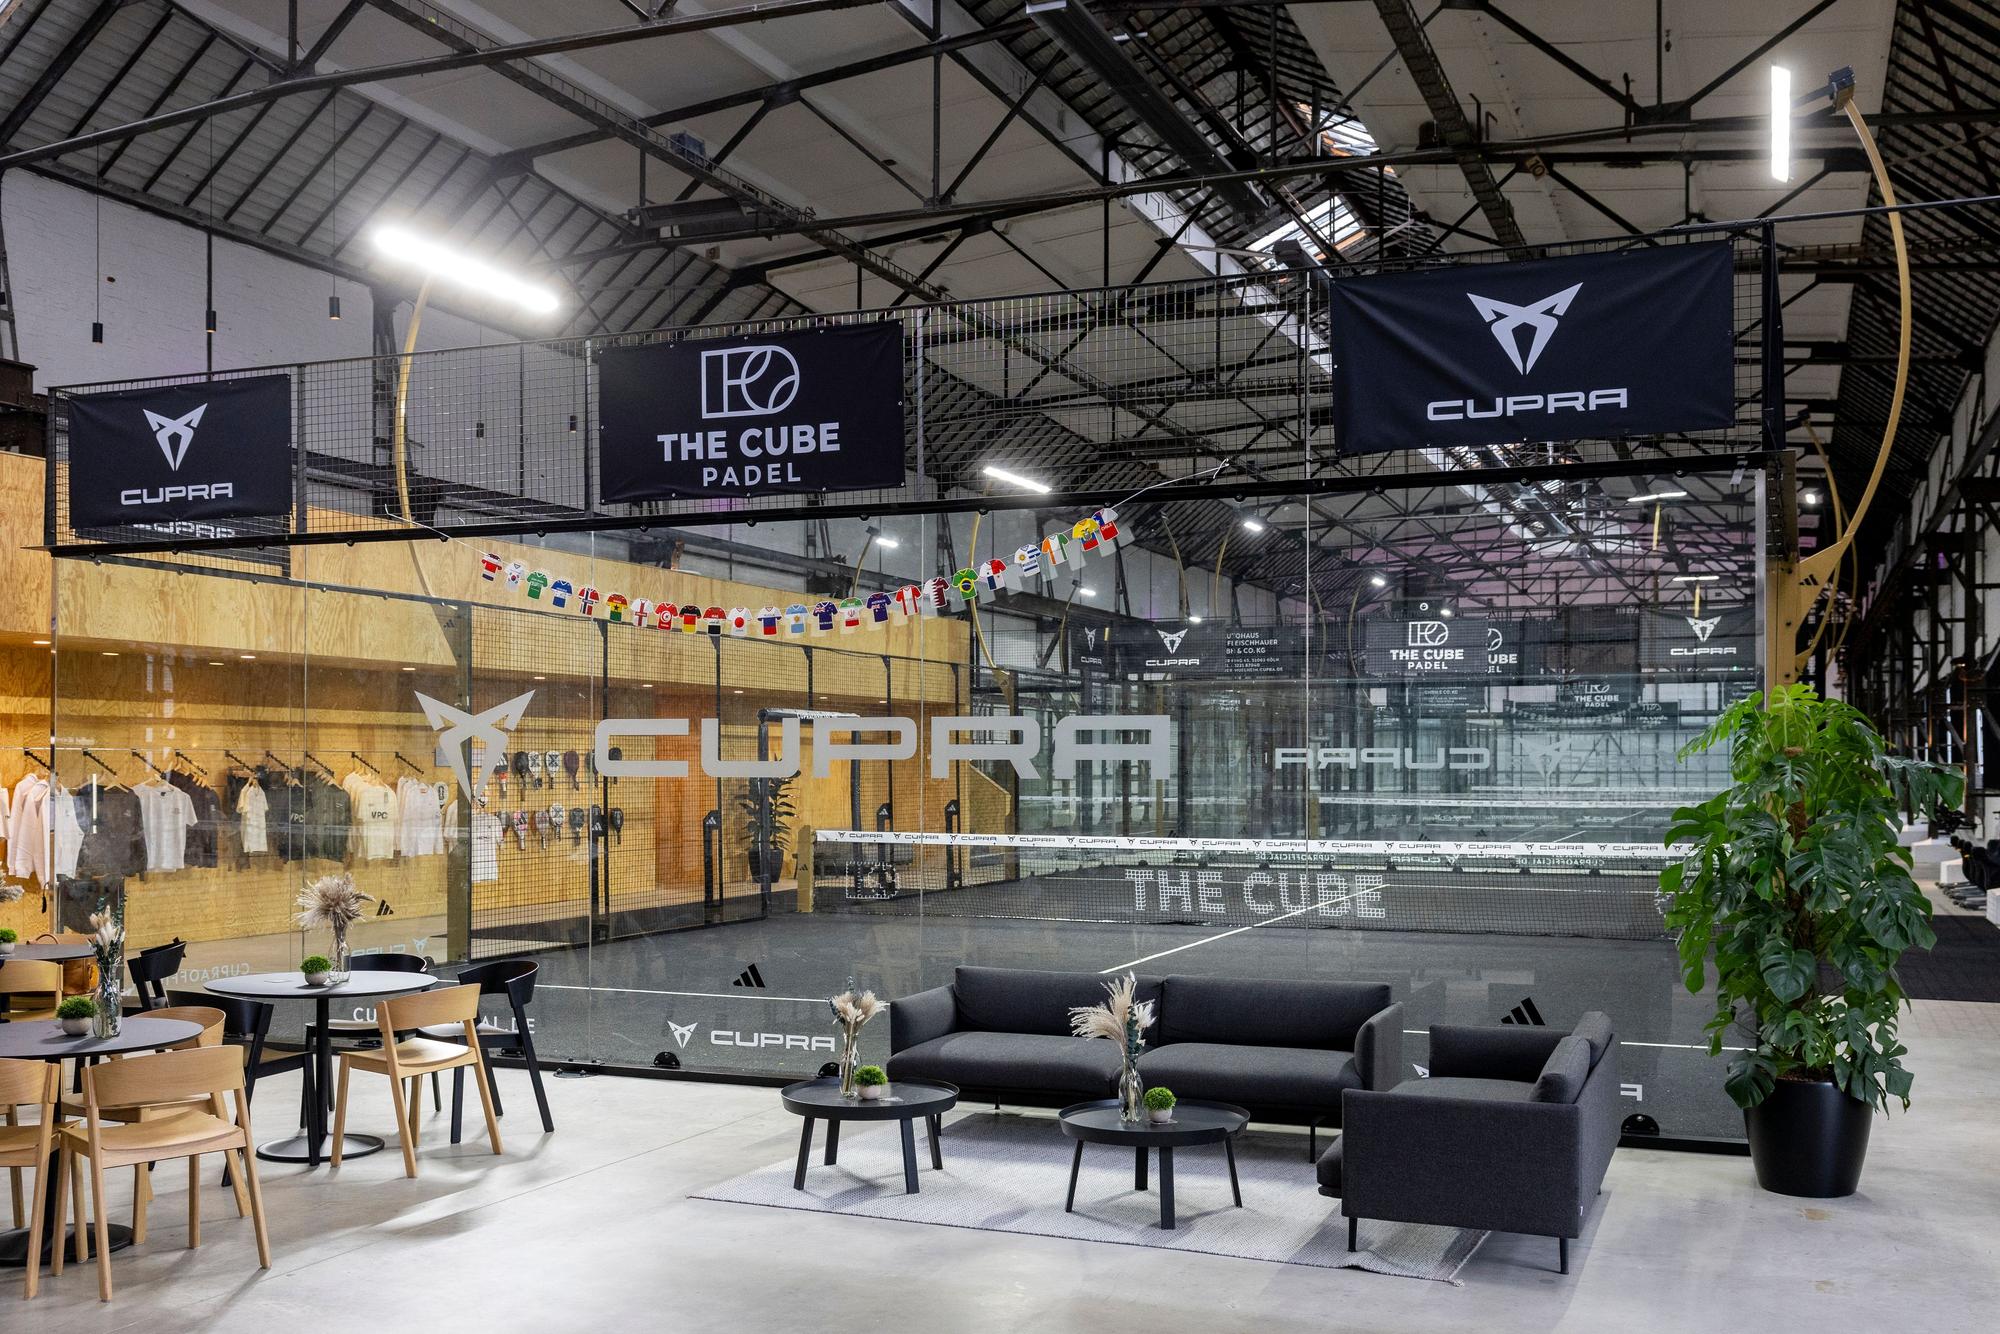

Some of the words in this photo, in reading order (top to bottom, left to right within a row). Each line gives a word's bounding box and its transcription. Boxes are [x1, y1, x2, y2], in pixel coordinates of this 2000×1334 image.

[1427, 388, 1628, 421] CUPRA
[657, 429, 727, 462] THE
[739, 422, 841, 457] CUBE
[702, 462, 802, 487] PADEL
[120, 482, 233, 505] CUPRA
[1146, 658, 1200, 666] CUPRA
[1390, 649, 1419, 660] THE
[1423, 649, 1464, 660] CUBE
[1488, 654, 1518, 664] UBE
[1670, 647, 1737, 656] CUPRA
[1408, 661, 1449, 669] PADEL
[595, 715, 1170, 780] CUPRA
[371, 811, 388, 819] VPC
[1125, 869, 1227, 913] THE
[1243, 872, 1386, 918] CUBE
[711, 1030, 835, 1052] CUPRA
